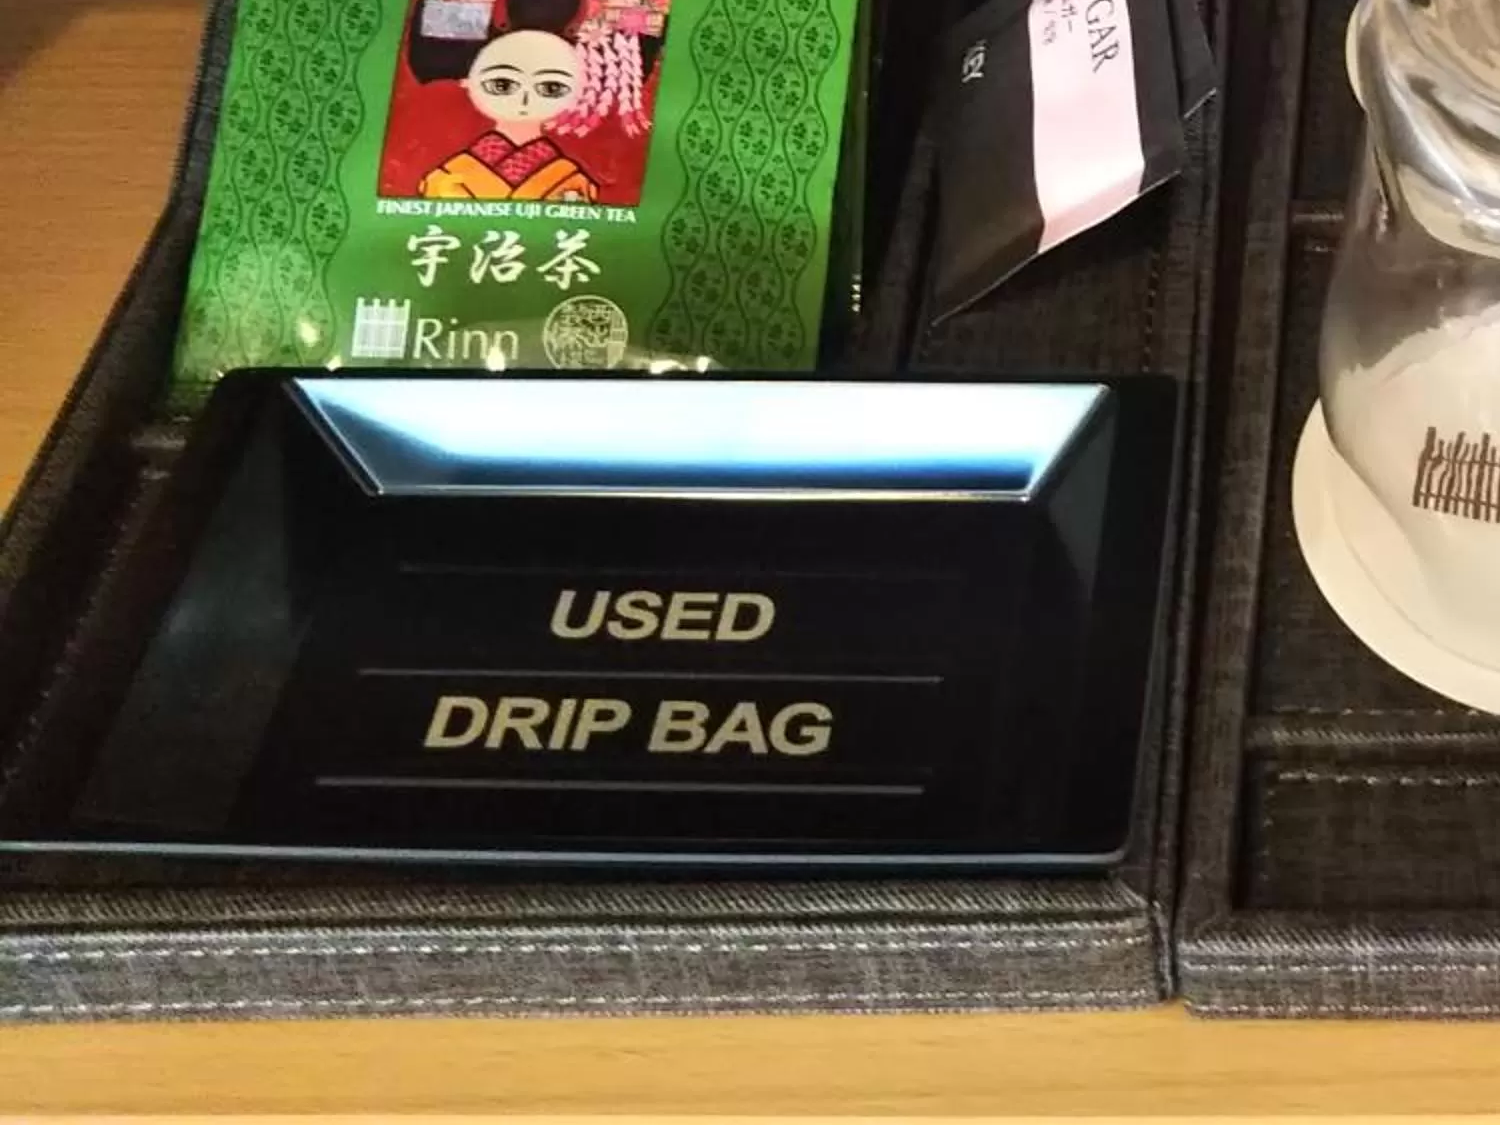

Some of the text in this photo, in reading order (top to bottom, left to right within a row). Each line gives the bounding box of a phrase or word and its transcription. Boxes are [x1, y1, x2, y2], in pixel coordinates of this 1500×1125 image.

[377, 200, 637, 224] FINEST JAPANESE UJI GREEN TEA
[406, 225, 602, 291] 宇治茶
[412, 317, 519, 361] Rinn
[550, 589, 776, 642] USED
[424, 696, 833, 755] DRIP BAG
